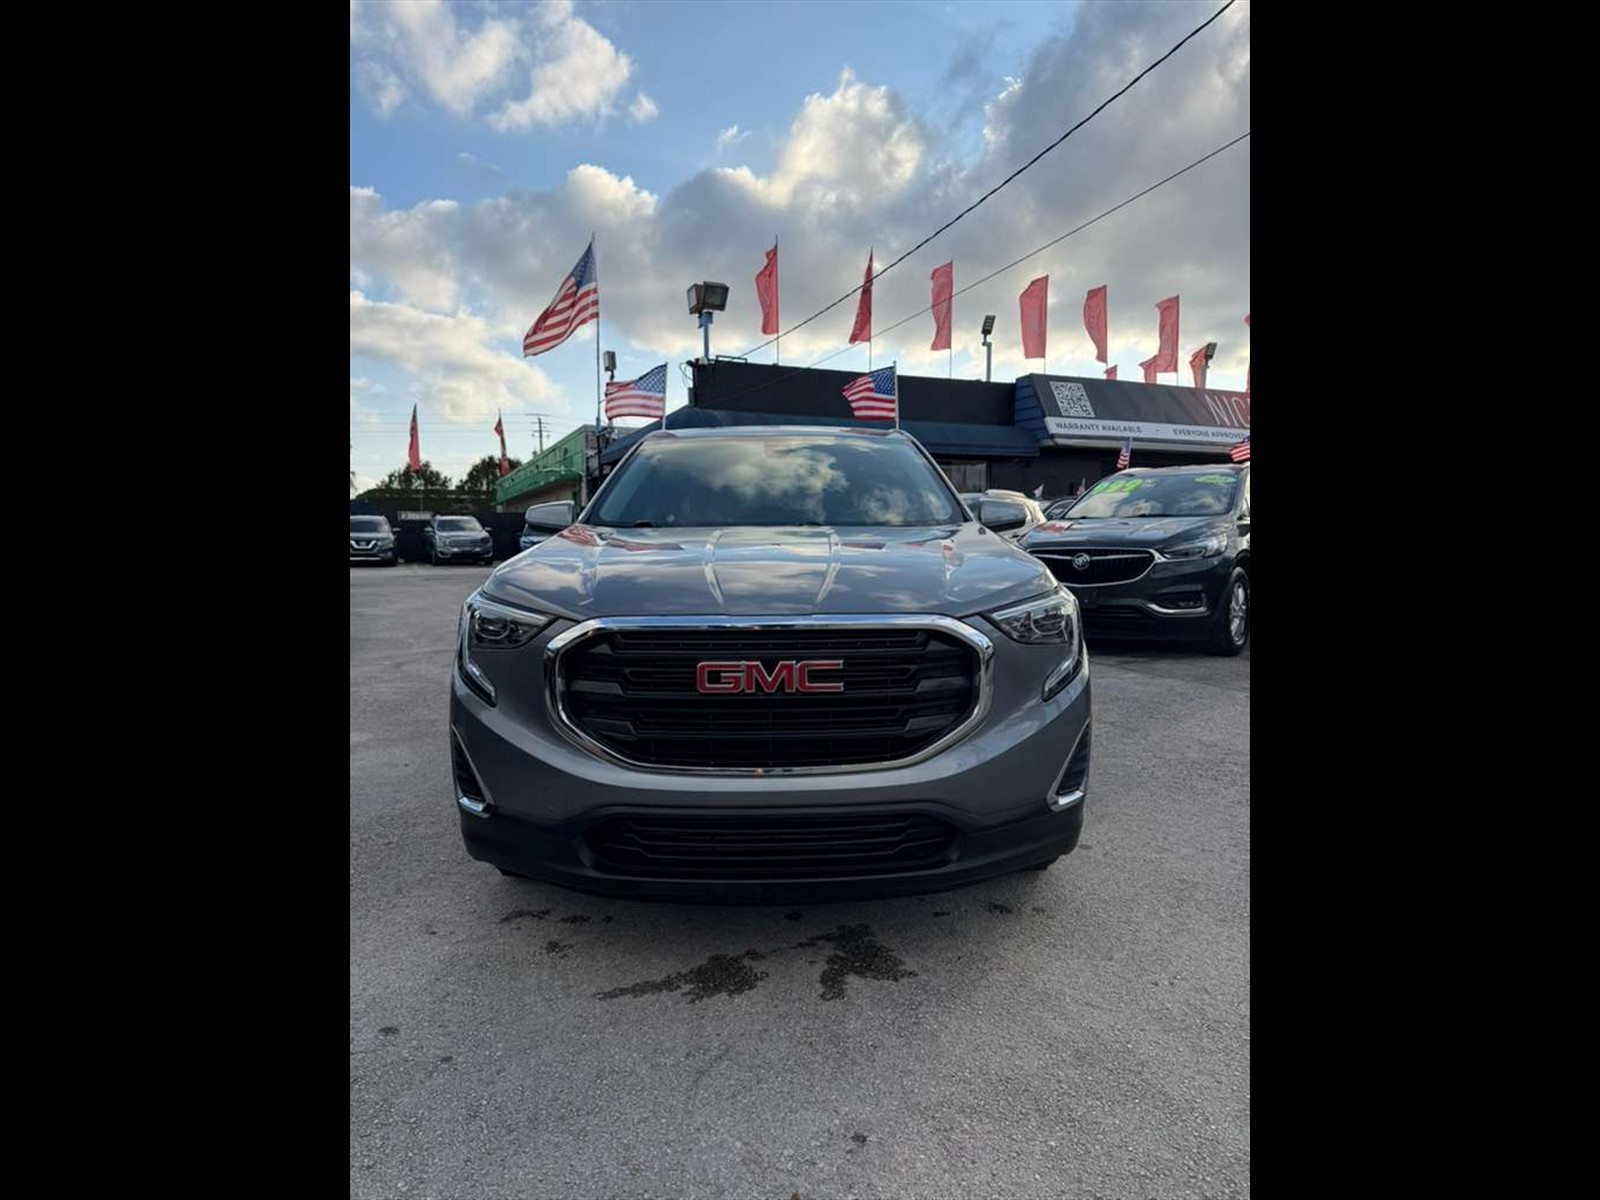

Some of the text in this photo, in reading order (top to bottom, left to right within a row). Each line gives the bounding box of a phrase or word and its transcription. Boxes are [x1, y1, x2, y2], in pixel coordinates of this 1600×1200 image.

[1203, 393, 1250, 429] NIC
[1054, 422, 1100, 431] WARRANTY
[1101, 424, 1143, 433] AVAILABLE
[1172, 428, 1210, 438] EVERYONE
[696, 659, 844, 694] GMC
